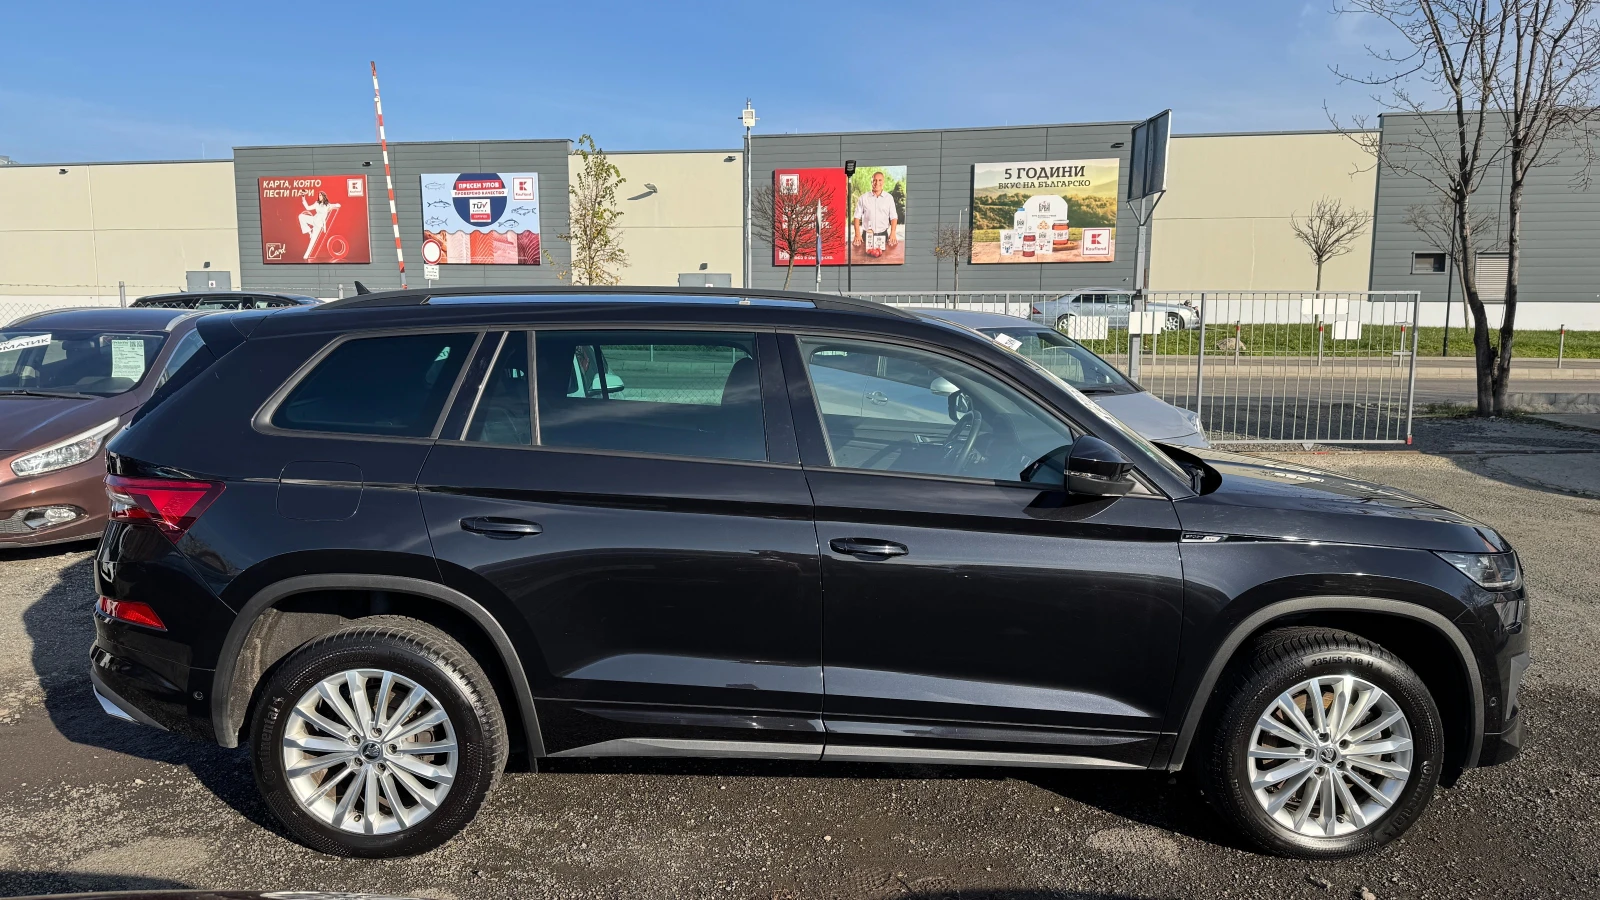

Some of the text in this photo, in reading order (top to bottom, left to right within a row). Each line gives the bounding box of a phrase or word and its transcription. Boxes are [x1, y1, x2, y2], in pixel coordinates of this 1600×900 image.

[1004, 165, 1086, 180] 5 ГОДИНИ
[263, 179, 322, 189] КАРТА, КОЯТО
[1038, 180, 1091, 188] БЪЛГАРСКО
[263, 189, 290, 198] ПЕСТИ
[1311, 656, 1343, 667] 235/55
[1354, 657, 1363, 666] 18
